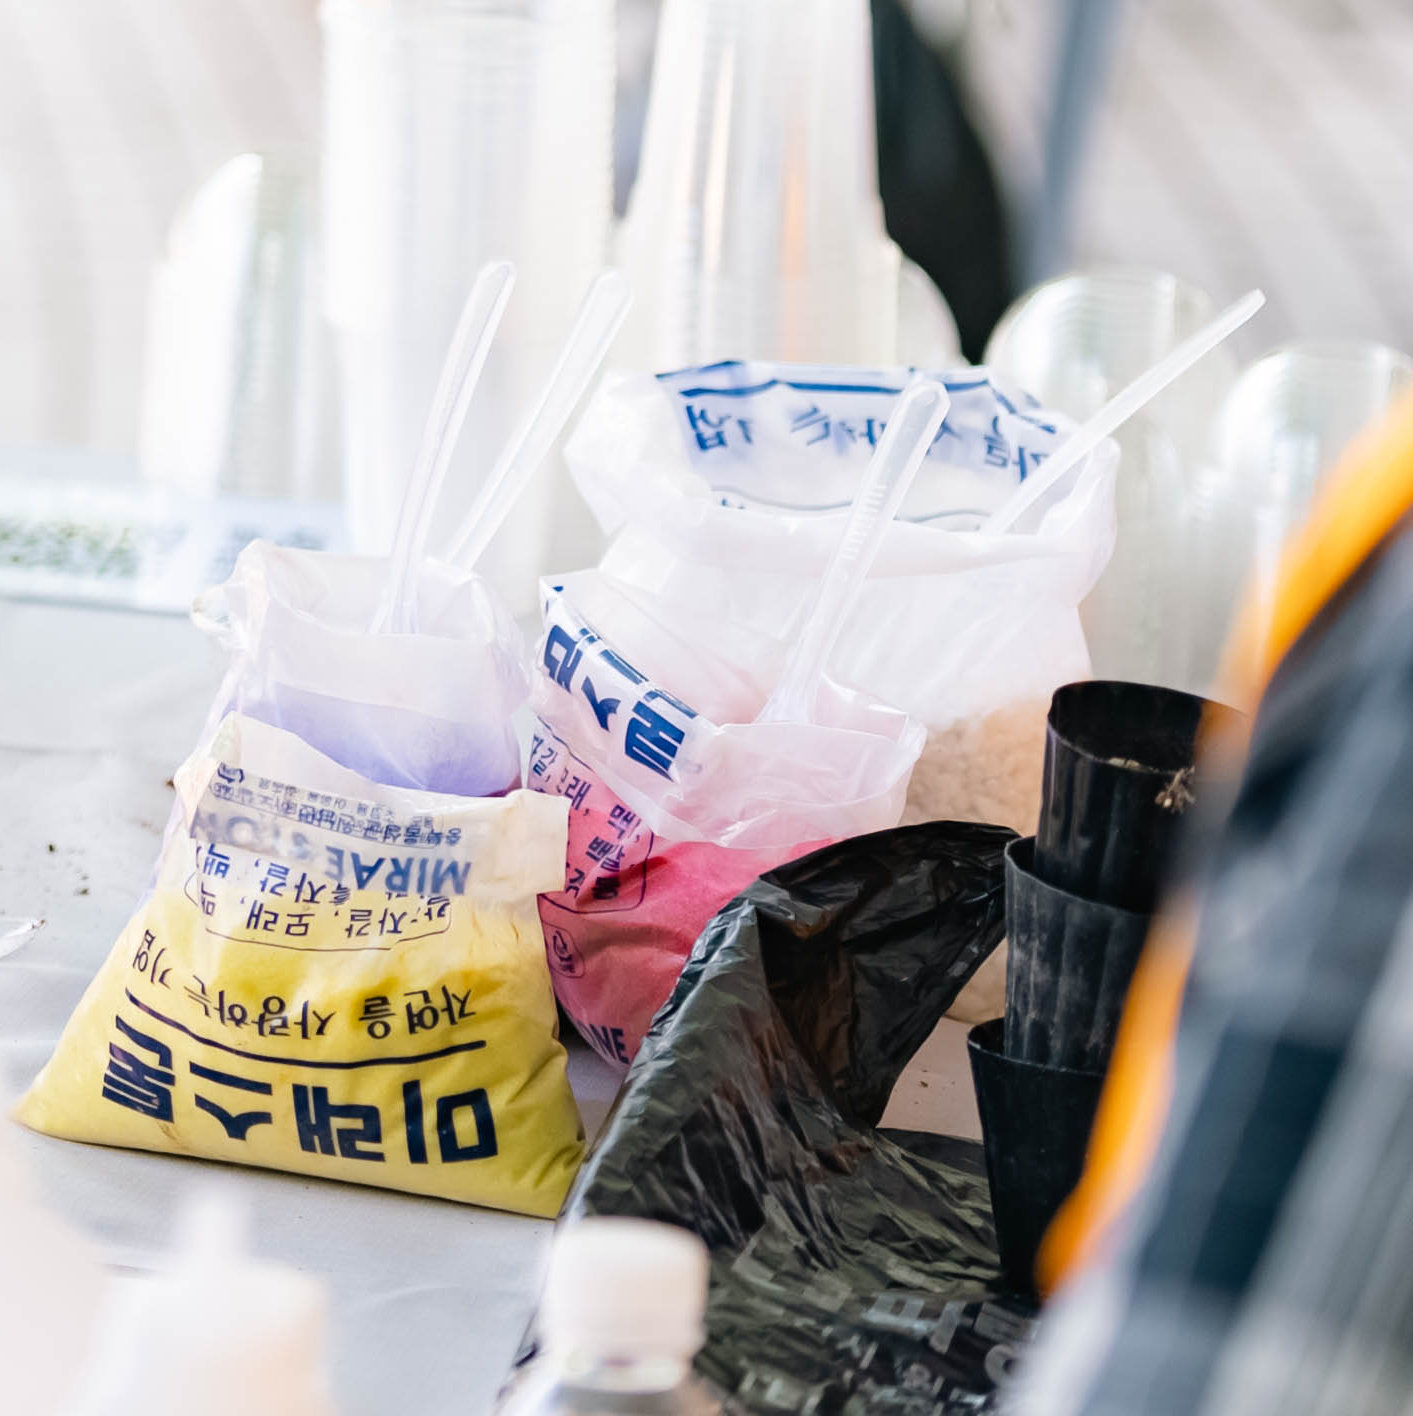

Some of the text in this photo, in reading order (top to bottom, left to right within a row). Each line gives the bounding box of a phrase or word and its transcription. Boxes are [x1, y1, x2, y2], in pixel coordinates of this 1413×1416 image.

[324, 844, 473, 896] MIRAE
[240, 895, 311, 937] 모래,
[130, 927, 477, 1041] 자연을 사랑하는 기업
[101, 1013, 500, 1165] 미래스톤
